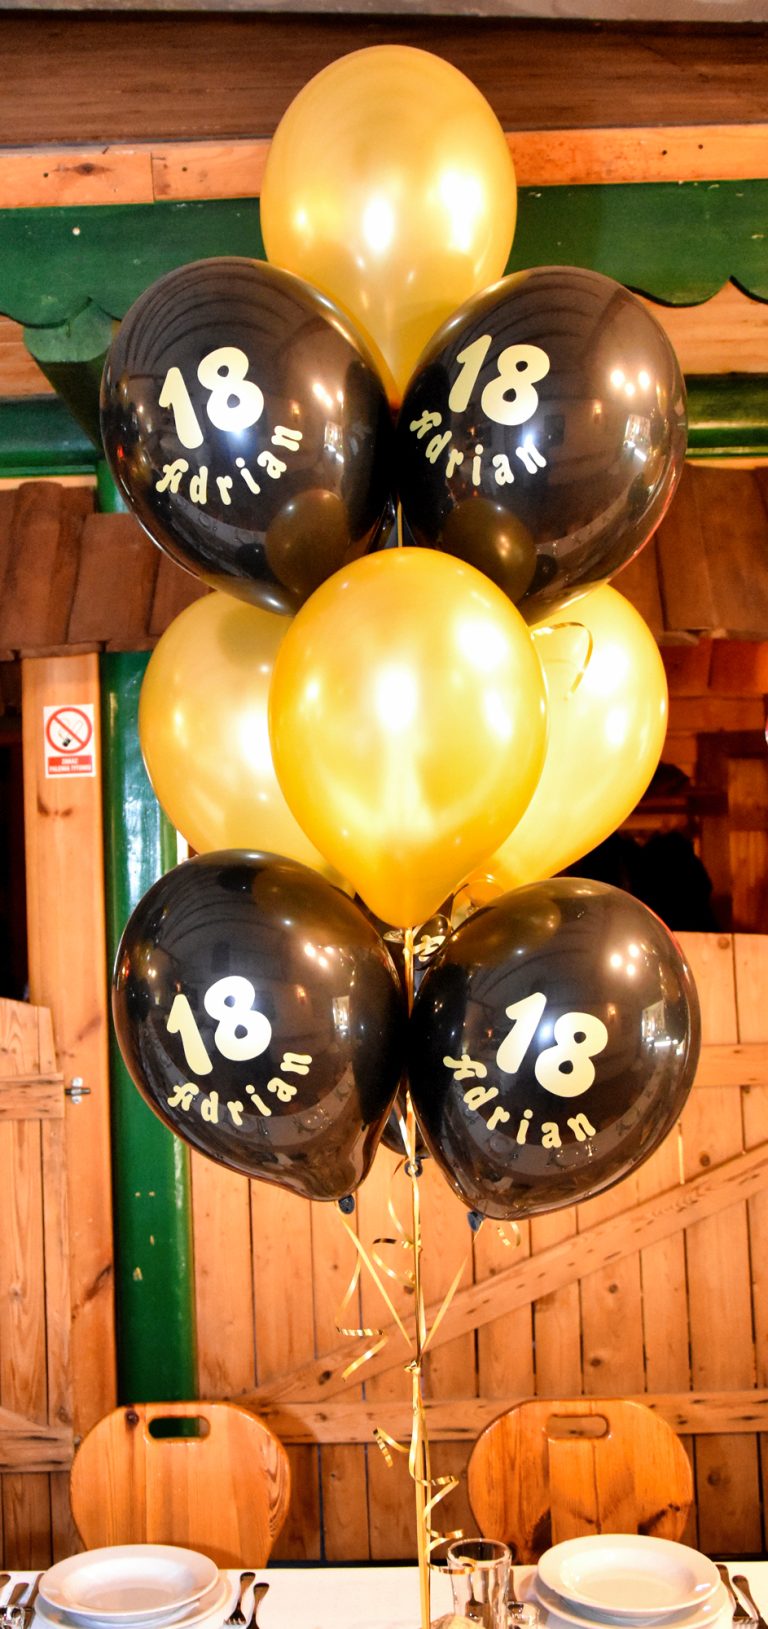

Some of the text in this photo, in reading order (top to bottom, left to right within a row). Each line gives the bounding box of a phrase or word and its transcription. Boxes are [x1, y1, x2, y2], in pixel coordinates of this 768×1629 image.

[159, 347, 264, 449] 18
[448, 335, 550, 425] 18
[157, 426, 303, 506] Adrian
[410, 410, 546, 486] Adrian
[167, 976, 272, 1075] 18
[496, 992, 608, 1097] 18
[168, 1053, 312, 1126] Adrian
[443, 1055, 596, 1148] Adrian
